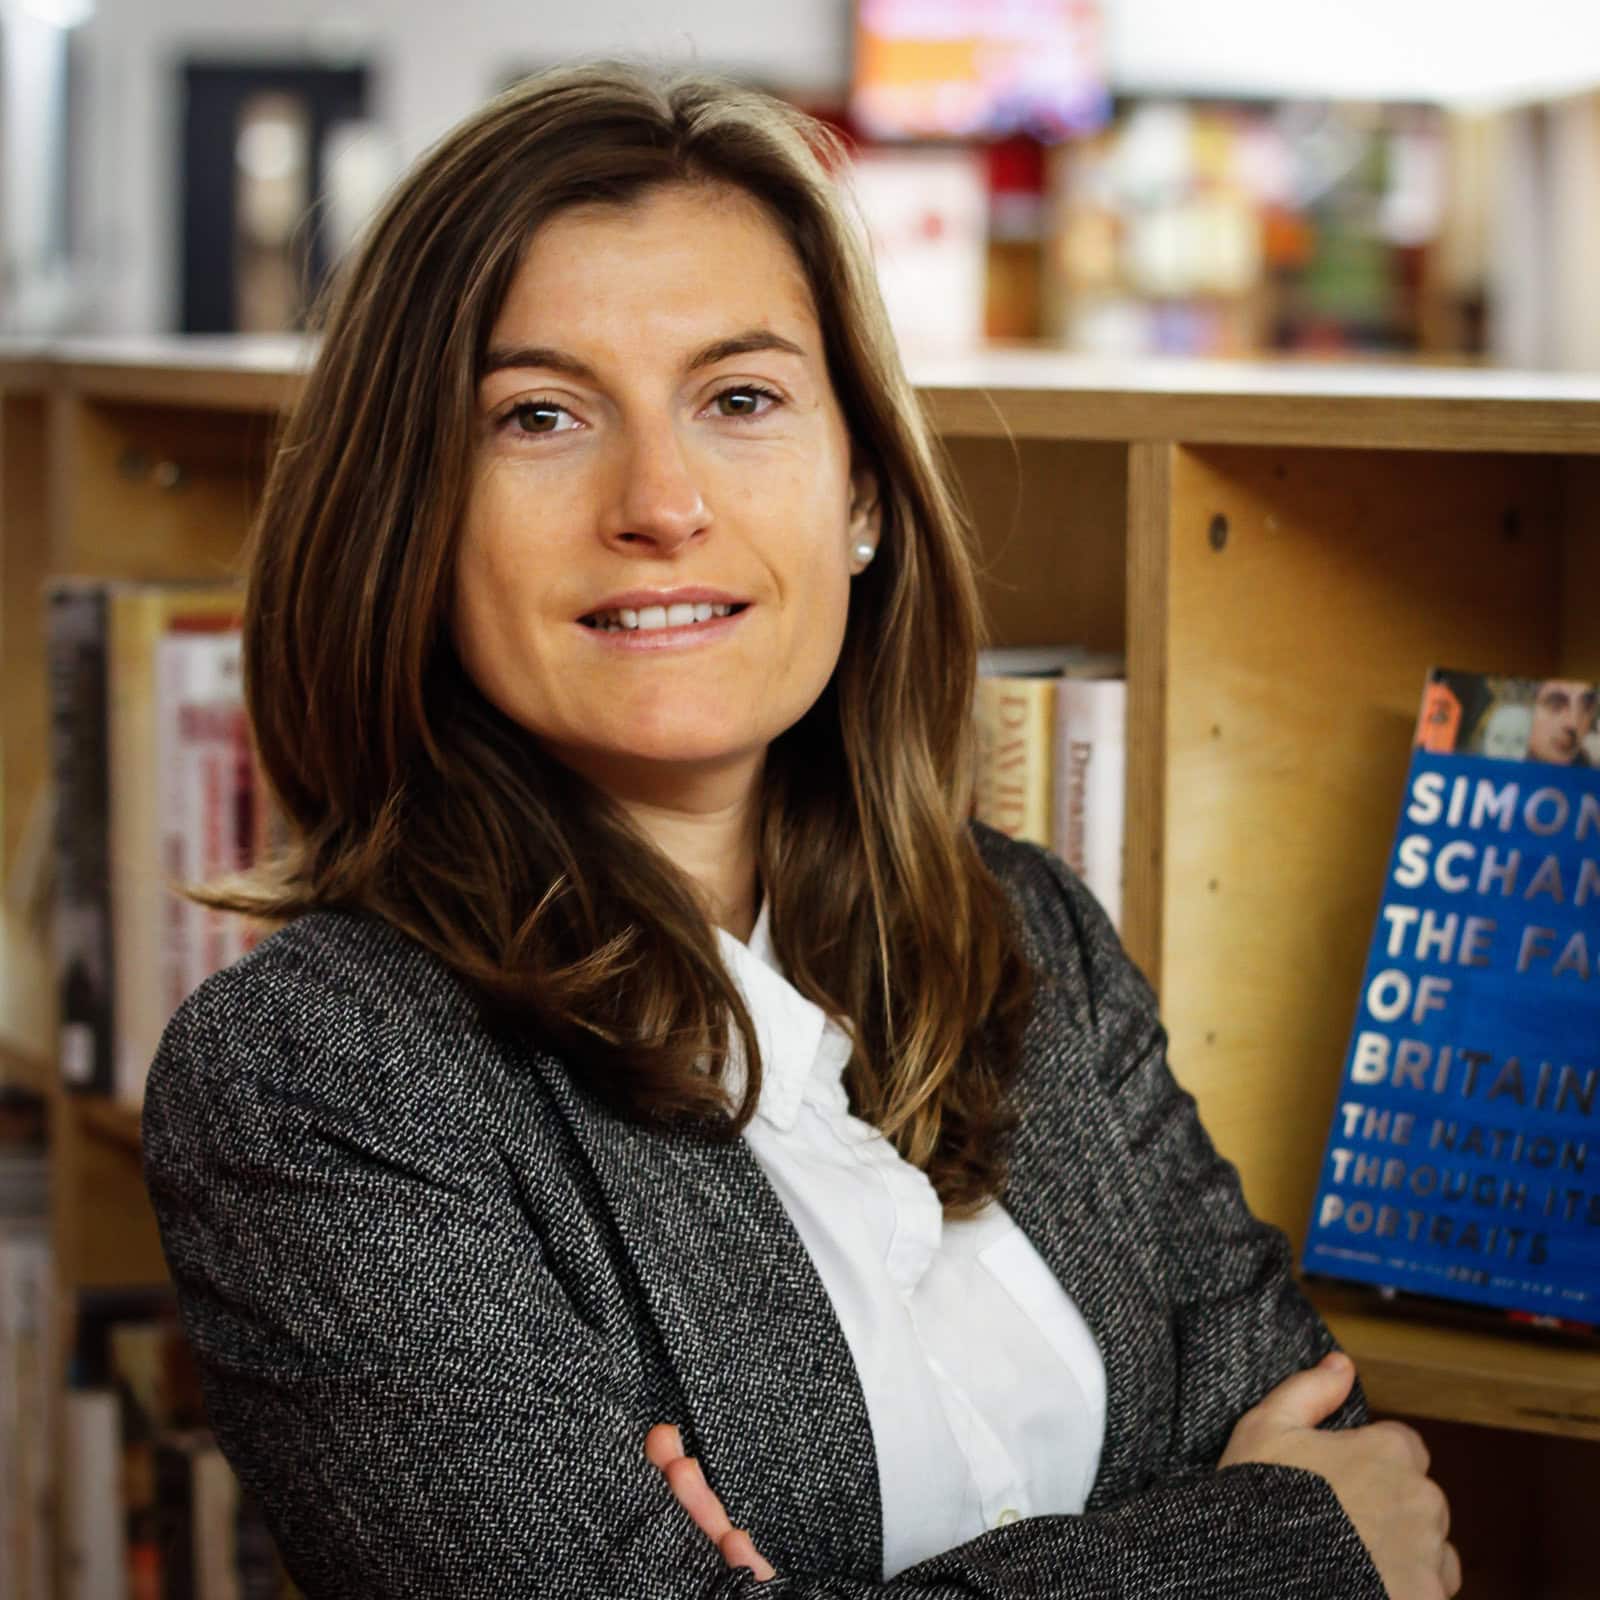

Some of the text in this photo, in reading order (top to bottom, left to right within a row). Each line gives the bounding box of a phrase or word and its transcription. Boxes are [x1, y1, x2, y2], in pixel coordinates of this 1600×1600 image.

[1383, 904, 1600, 982] THE FA
[1367, 969, 1452, 1024] OF
[1351, 1031, 1598, 1117] BRITAIN
[1342, 1102, 1588, 1175] THE NATION
[1332, 1148, 1527, 1210] THROUGH
[1319, 1194, 1549, 1264] PORTRAITS
